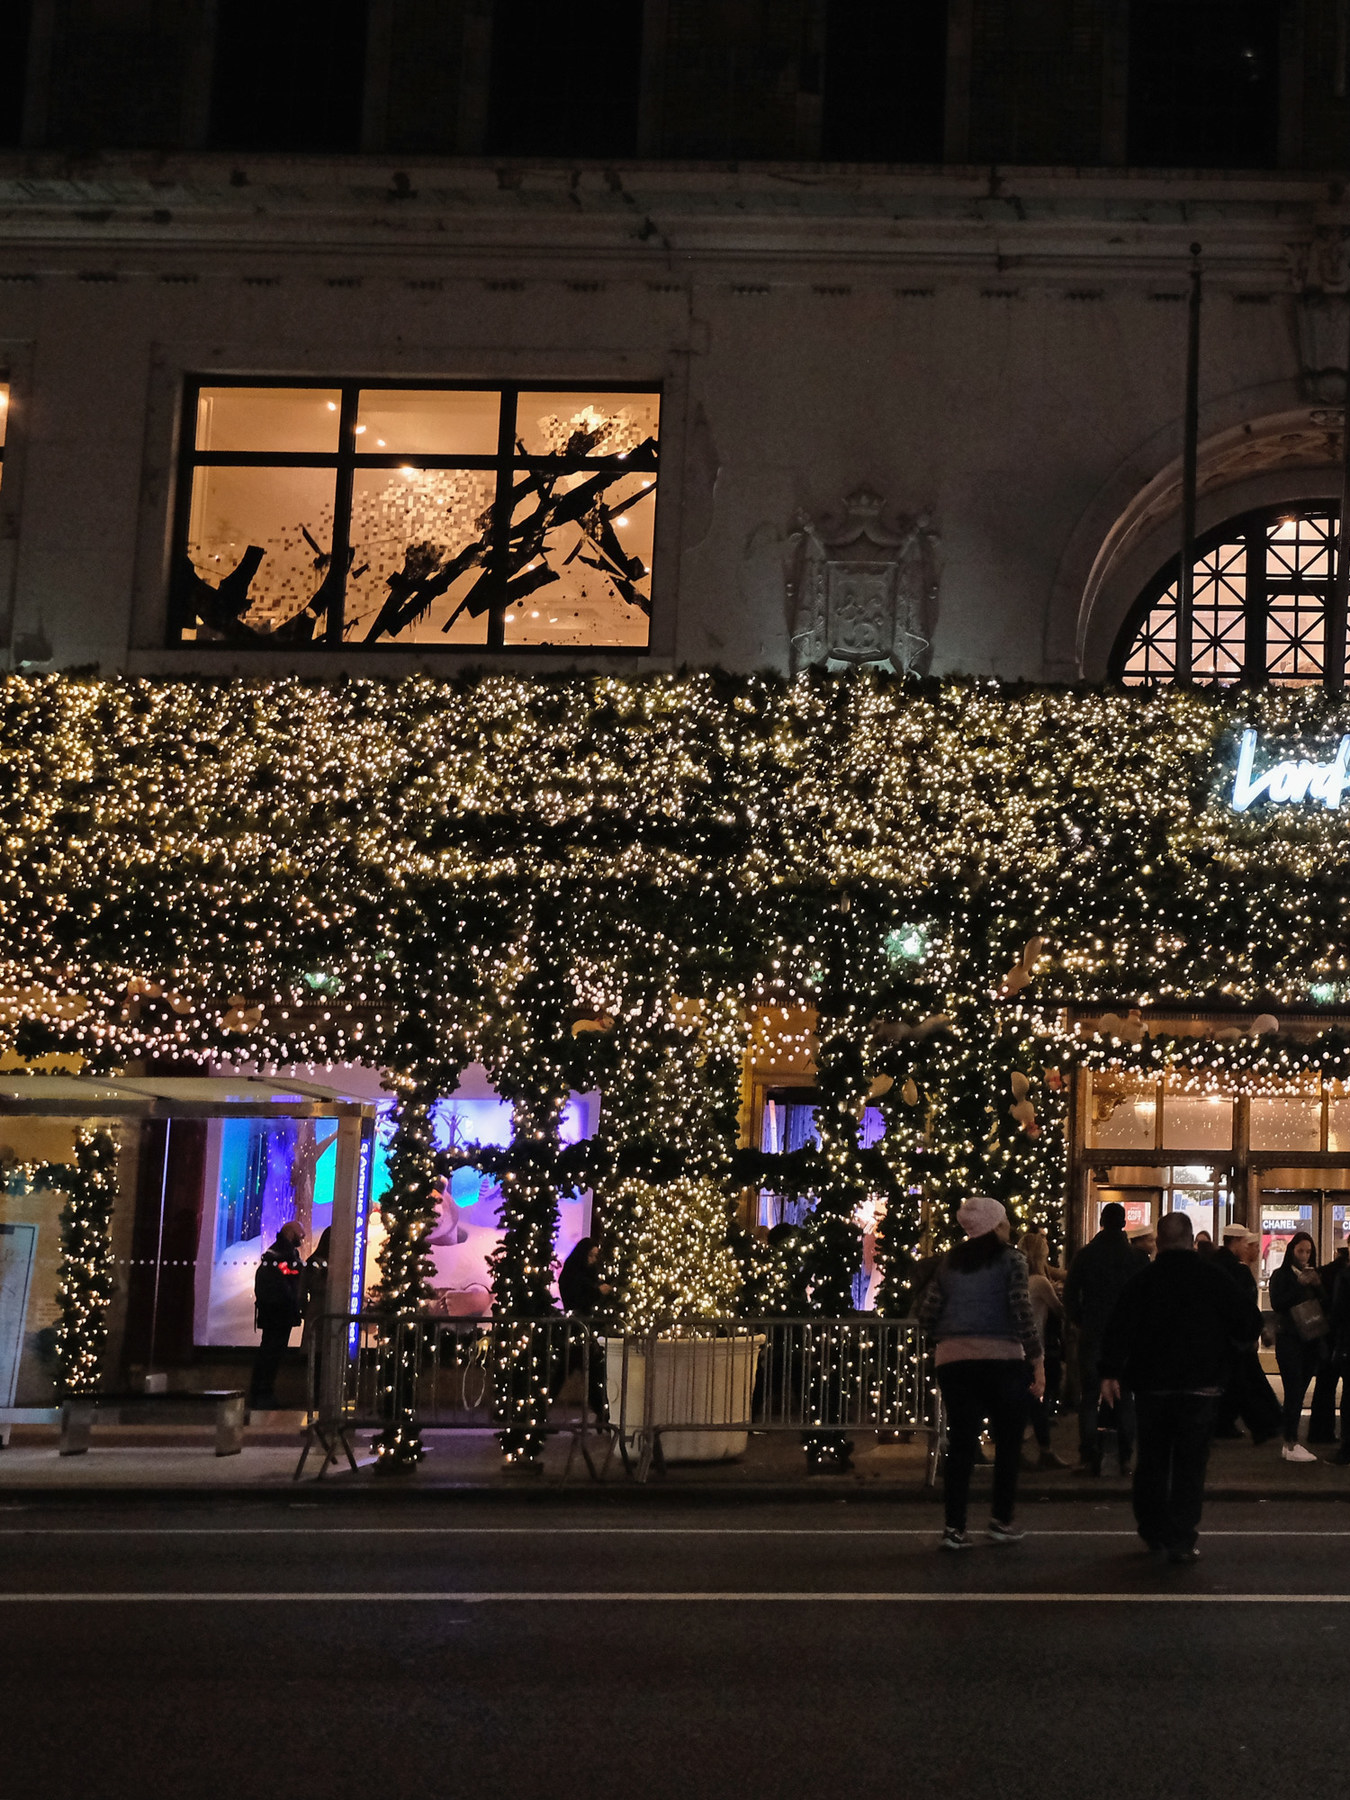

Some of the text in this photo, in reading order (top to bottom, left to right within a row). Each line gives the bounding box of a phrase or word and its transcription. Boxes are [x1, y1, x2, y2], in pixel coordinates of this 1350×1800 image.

[357, 1155, 368, 1214] Avenue
[1262, 1219, 1297, 1229] CHANEL
[348, 1296, 359, 1344] Steet
